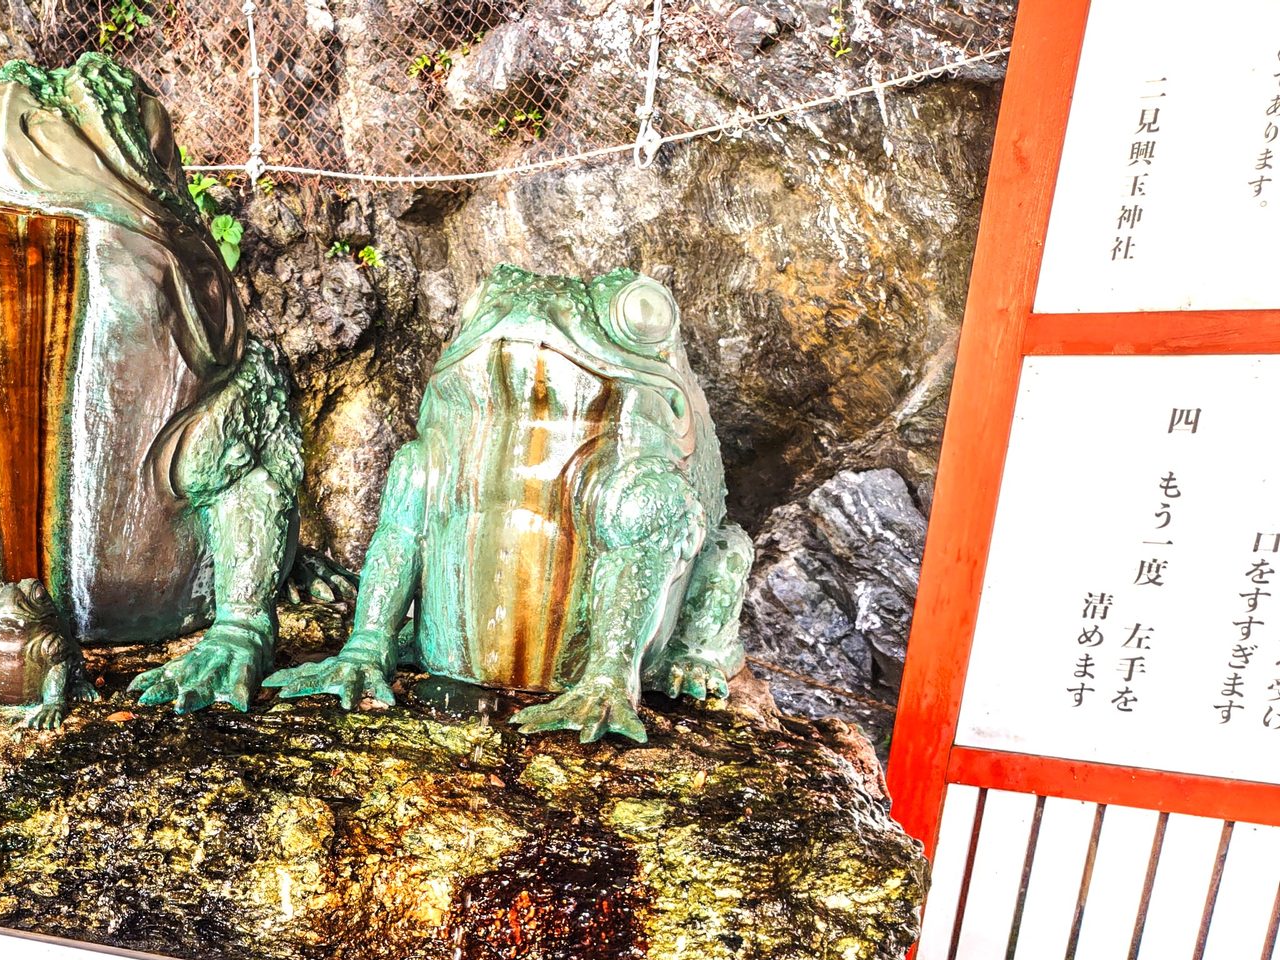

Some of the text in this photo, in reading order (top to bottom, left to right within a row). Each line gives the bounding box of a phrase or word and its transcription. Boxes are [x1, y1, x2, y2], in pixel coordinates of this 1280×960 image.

[1111, 77, 1167, 261] 二見興玉神社
[1066, 592, 1114, 707] 清めます
[1111, 407, 1201, 712] 四 もう一度 左手を
